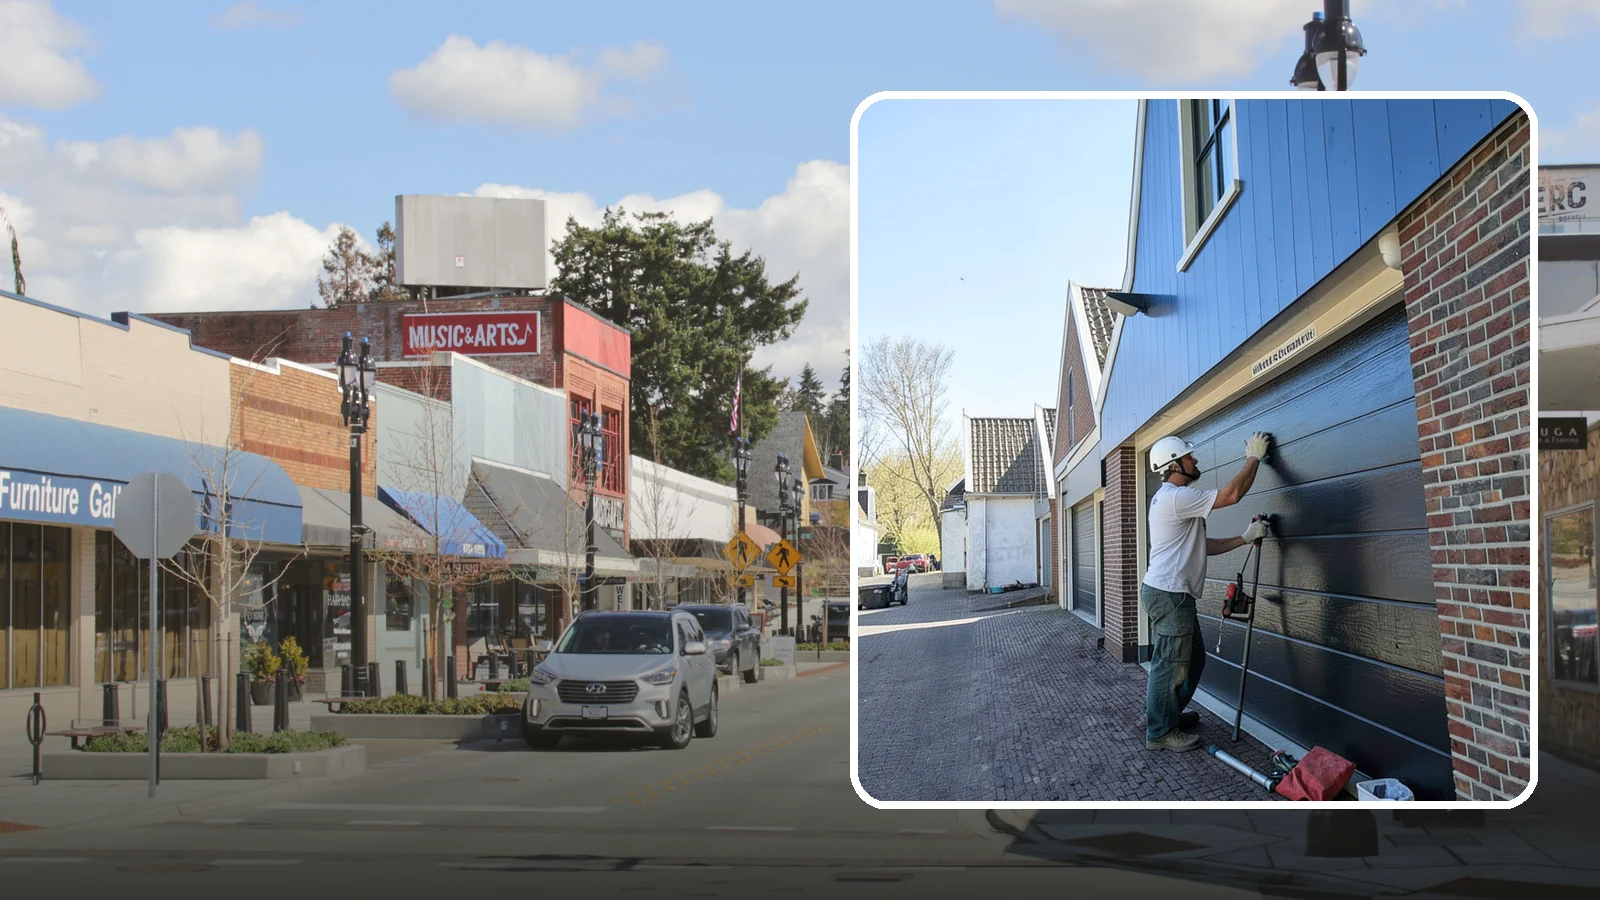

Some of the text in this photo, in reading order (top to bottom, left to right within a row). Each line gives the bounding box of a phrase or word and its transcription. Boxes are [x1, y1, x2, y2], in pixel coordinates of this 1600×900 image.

[1540, 427, 1577, 436] UGA
[0, 472, 122, 519] Furniture Gal
